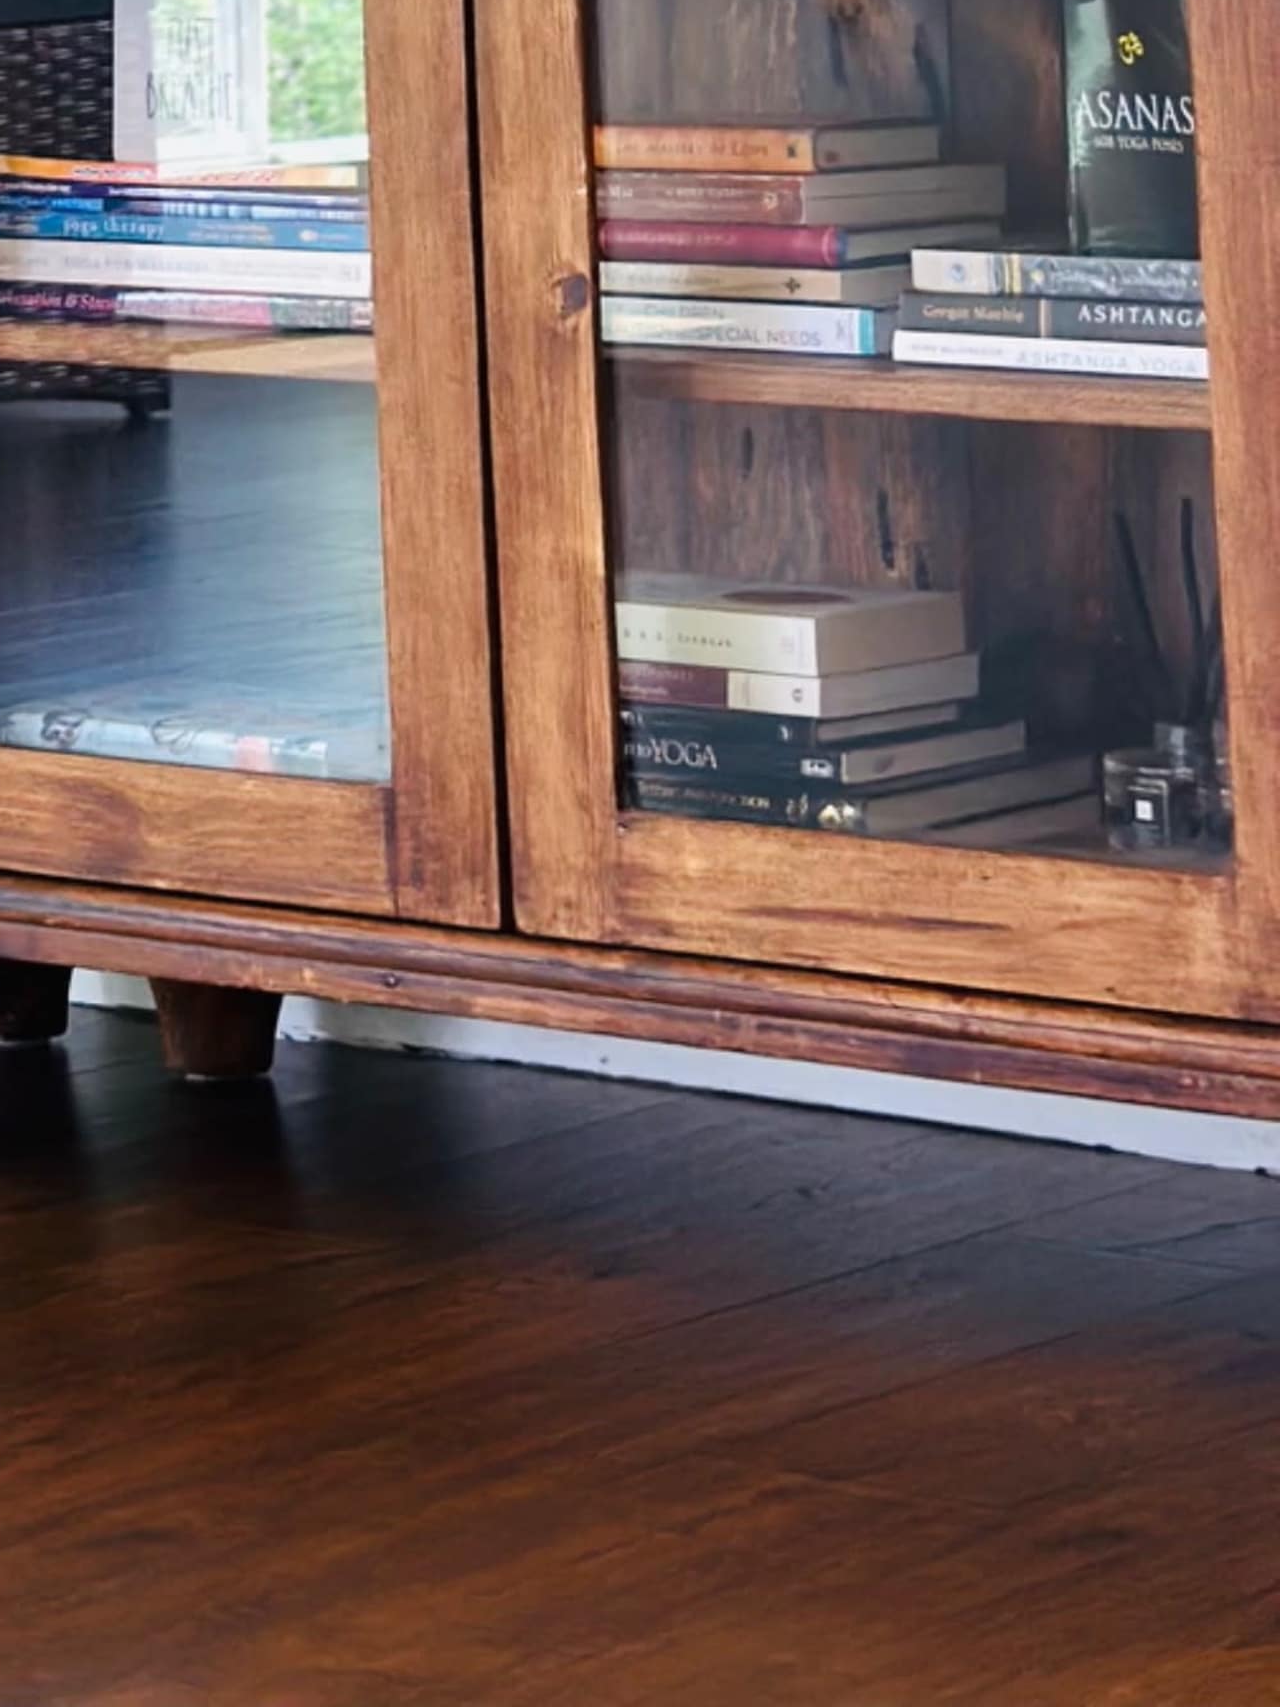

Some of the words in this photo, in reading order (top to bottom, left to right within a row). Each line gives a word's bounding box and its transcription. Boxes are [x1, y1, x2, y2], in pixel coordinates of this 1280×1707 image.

[145, 71, 234, 122] BREATHE
[1076, 89, 1195, 135] ASANAS
[1117, 135, 1149, 150] YOGA
[63, 218, 98, 237] yoga
[102, 216, 165, 240] therapy
[1077, 303, 1208, 328] ASHTANGA
[695, 328, 761, 345] SPECIAL
[766, 330, 822, 347] NEEDS
[1016, 350, 1129, 370] ASHTANGA
[1138, 355, 1198, 374] YOGA
[649, 737, 719, 769] YOGA
